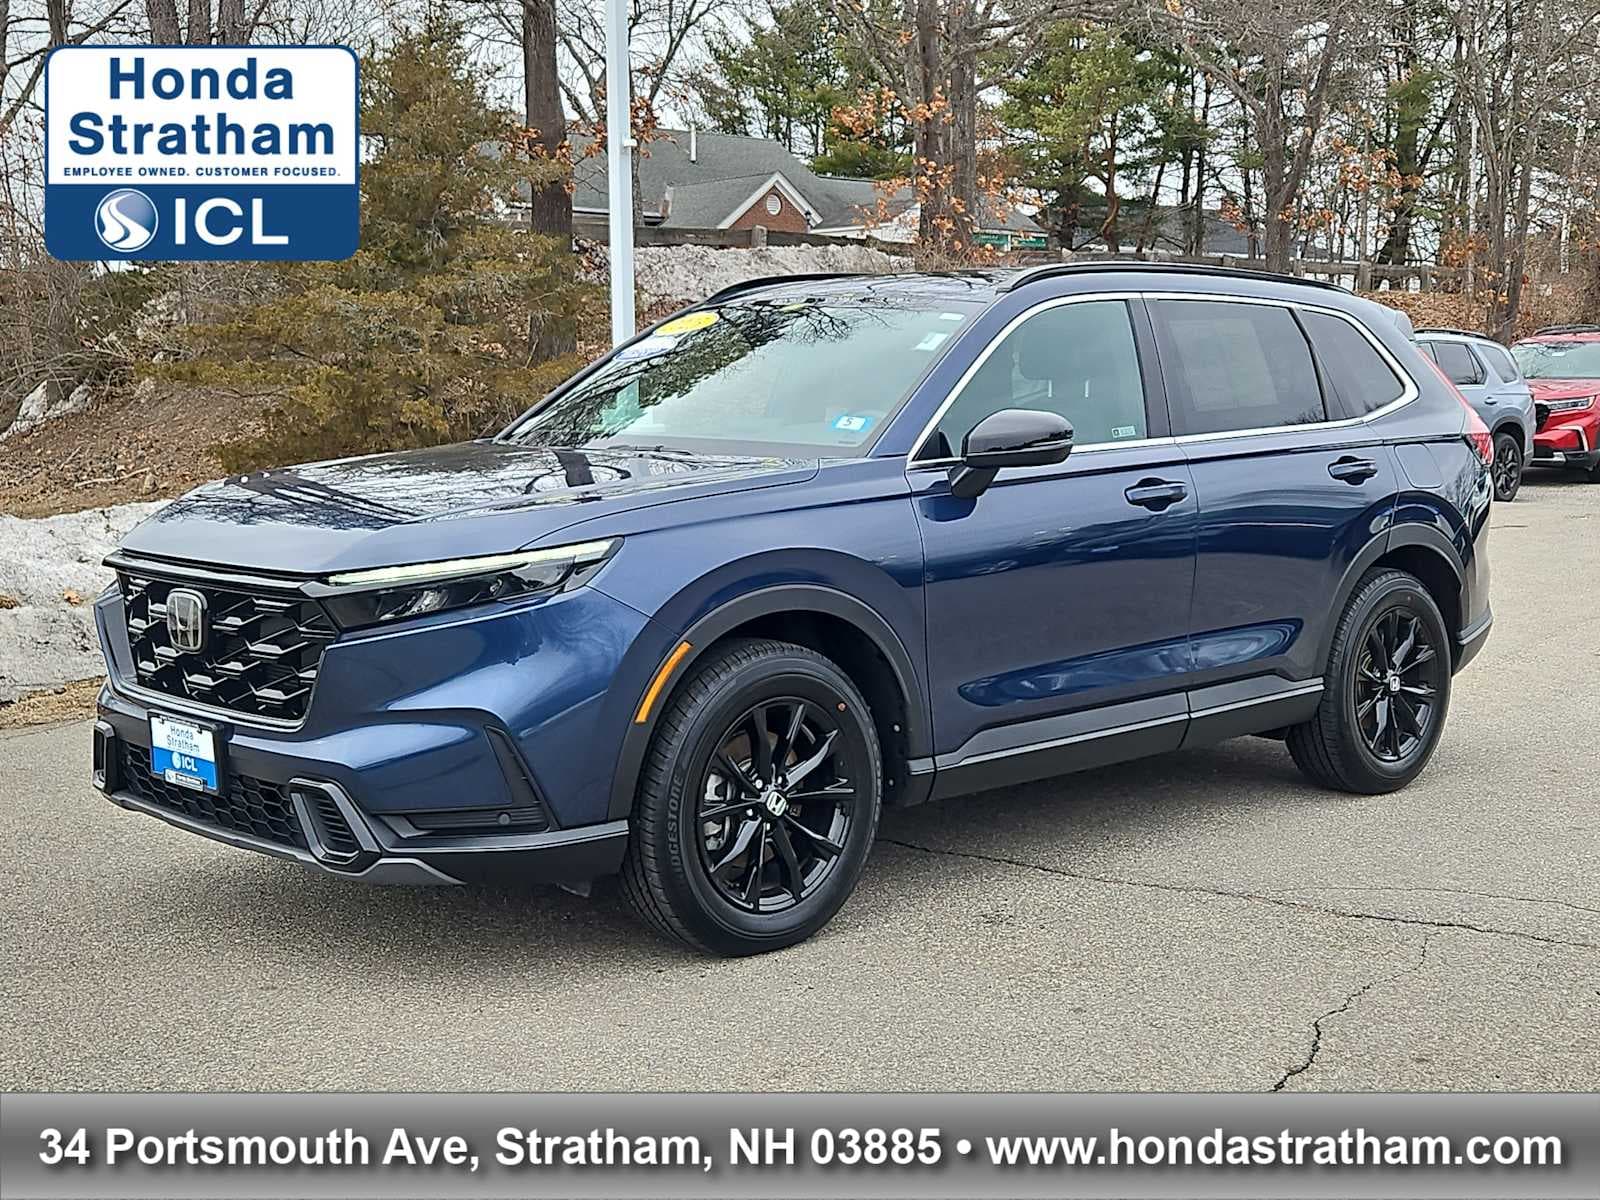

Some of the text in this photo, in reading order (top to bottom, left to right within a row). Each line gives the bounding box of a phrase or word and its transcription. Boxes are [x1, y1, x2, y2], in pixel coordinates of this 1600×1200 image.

[170, 725, 194, 740] Honda
[166, 735, 200, 753] Stratham
[181, 755, 198, 772] ICL
